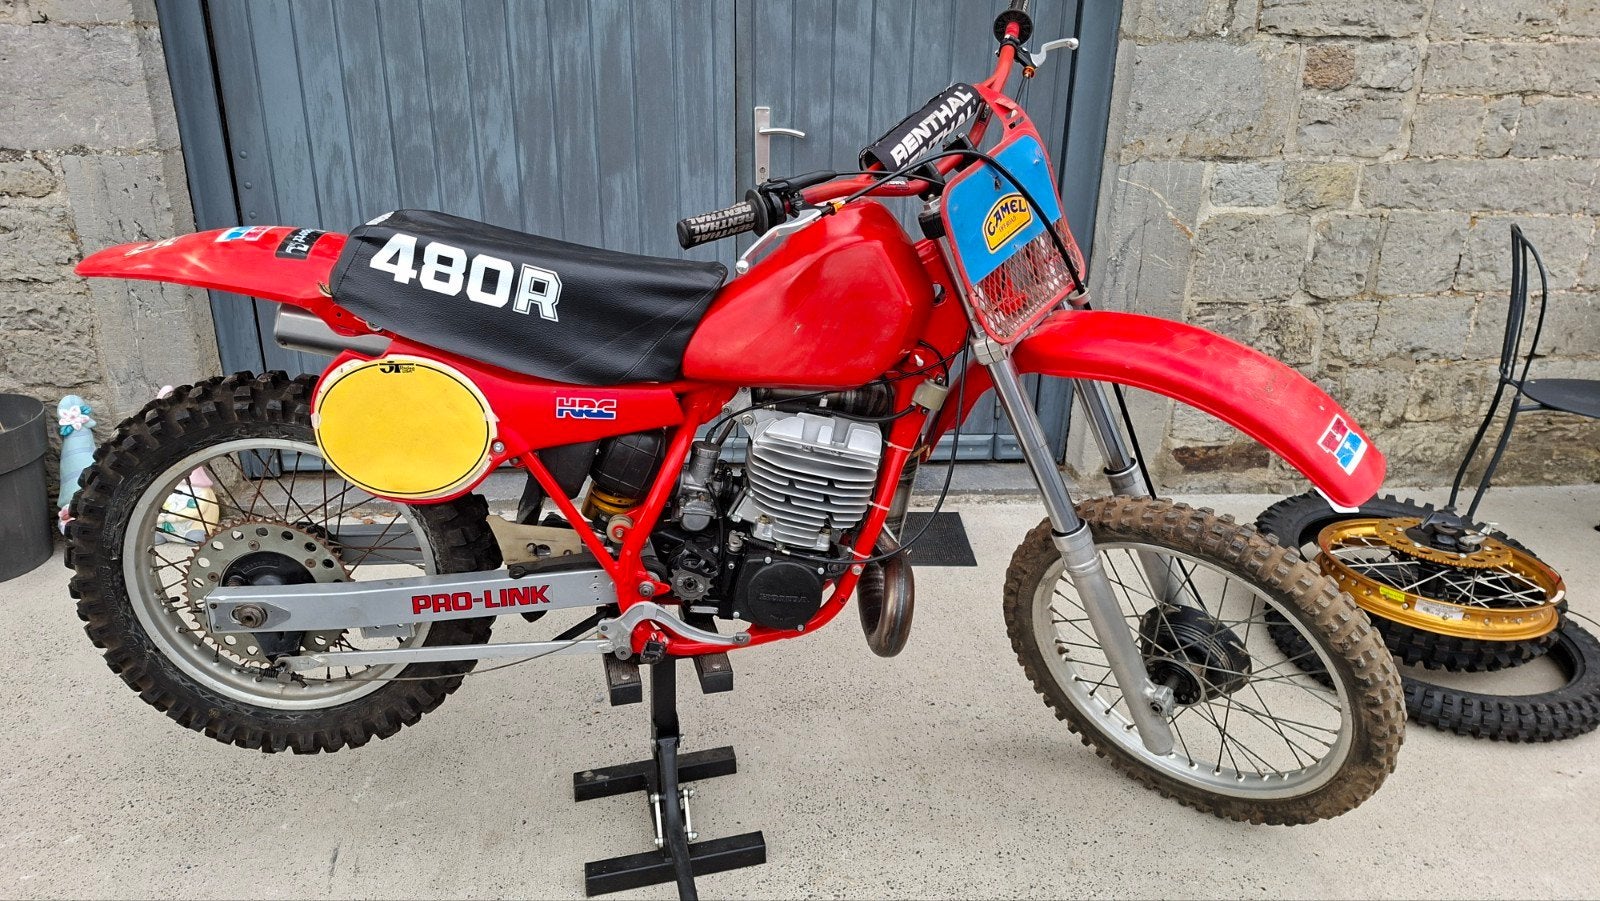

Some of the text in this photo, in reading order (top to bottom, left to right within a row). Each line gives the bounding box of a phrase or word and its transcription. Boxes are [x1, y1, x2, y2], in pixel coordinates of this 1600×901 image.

[890, 91, 973, 167] RENTHAL
[685, 204, 752, 225] RENTHAL
[690, 212, 755, 234] RENTHAL
[988, 200, 1026, 236] CAMEL
[692, 222, 756, 243] RENTHAL
[369, 233, 563, 322] 480R
[556, 397, 617, 420] HRC
[411, 585, 551, 615] PRO-LINK
